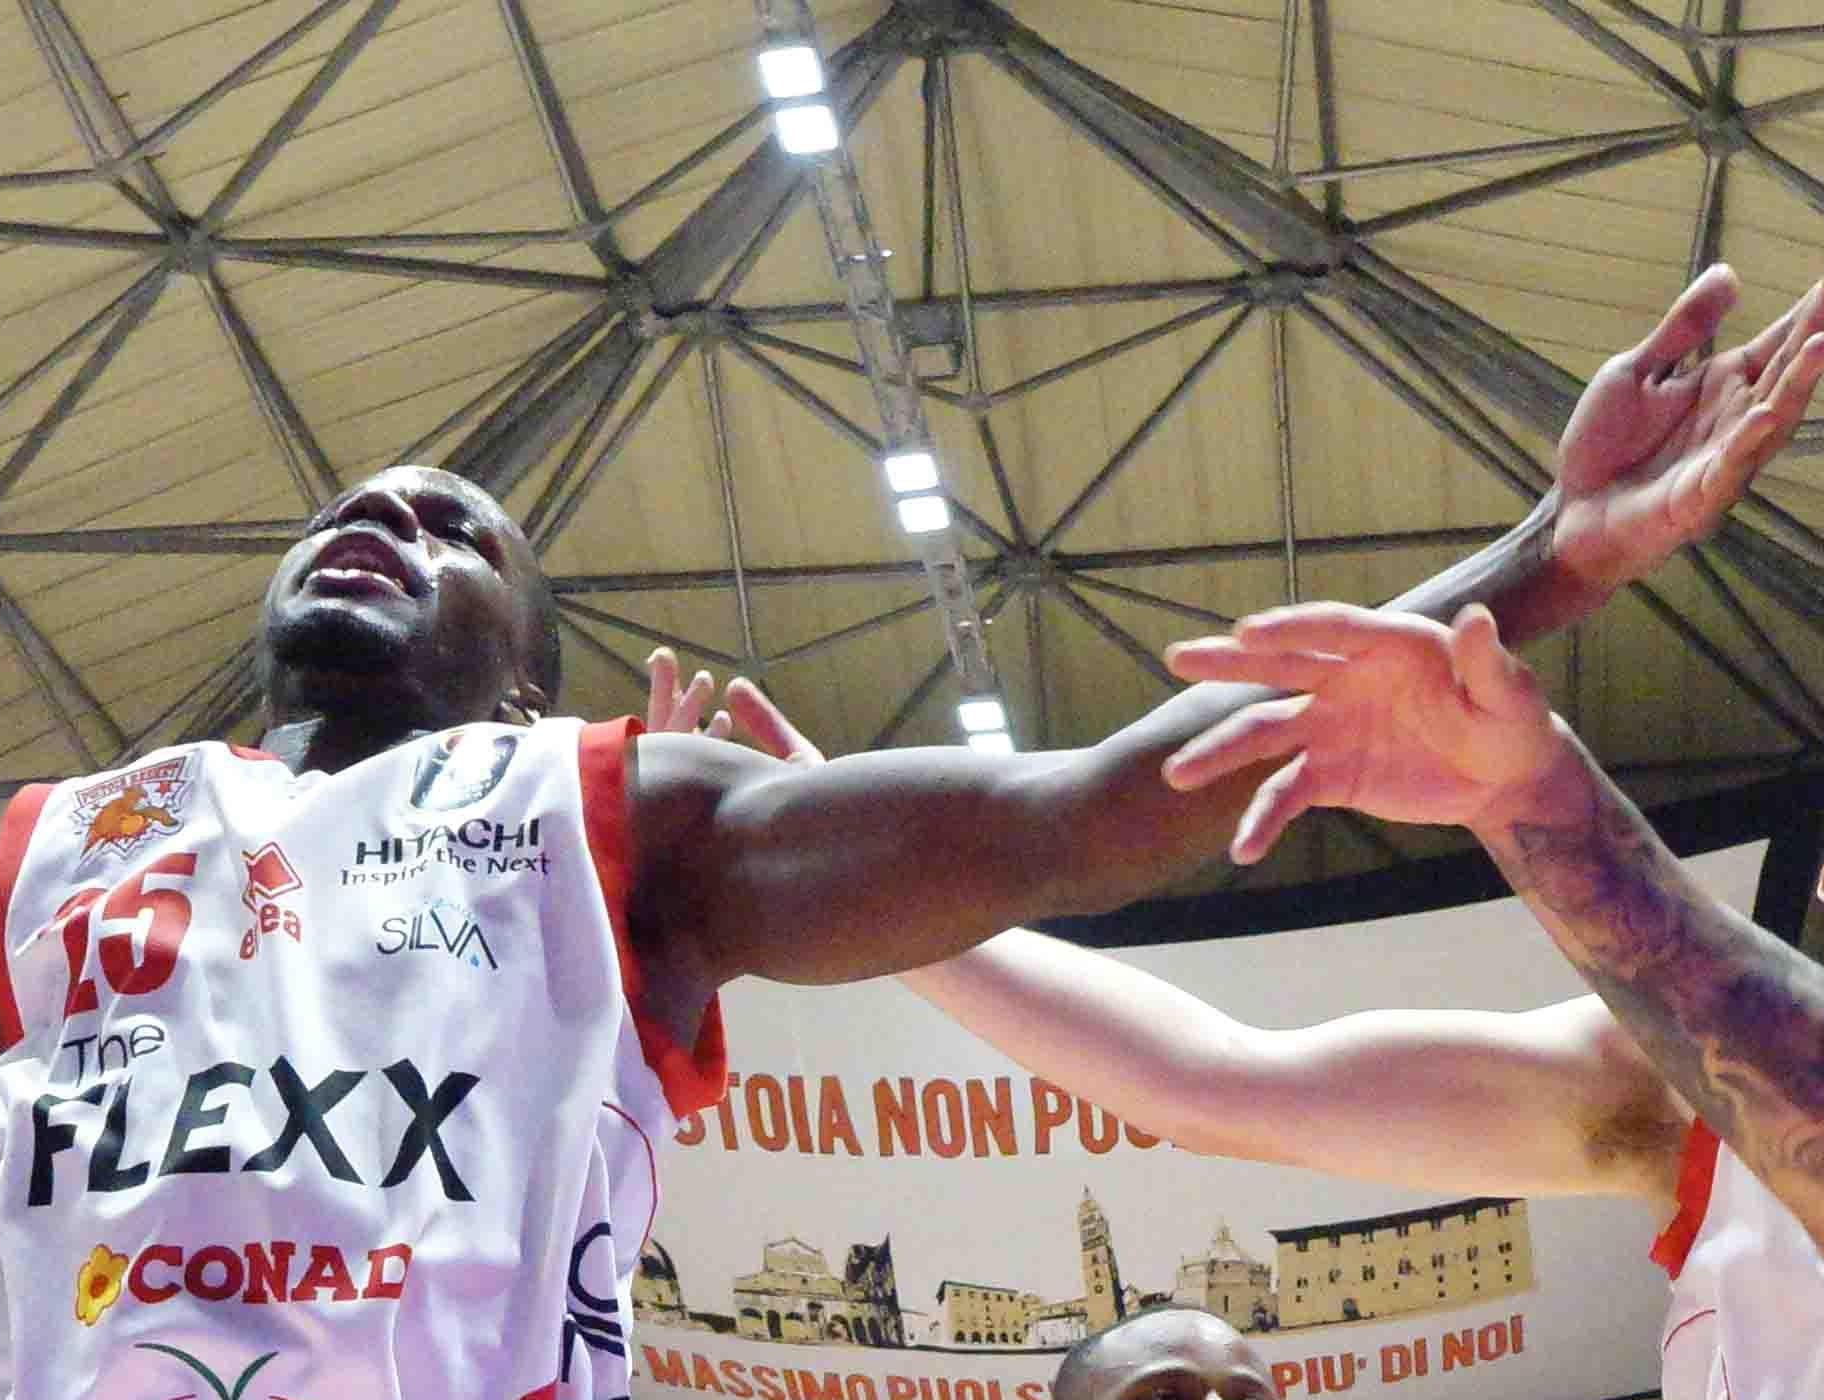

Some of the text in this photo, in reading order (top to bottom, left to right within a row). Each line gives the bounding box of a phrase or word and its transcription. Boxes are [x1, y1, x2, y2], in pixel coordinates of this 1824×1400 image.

[357, 819, 540, 866] HITACHI
[436, 846, 476, 874] the
[487, 853, 550, 876] Next
[377, 911, 497, 969] SILVA
[63, 1024, 164, 1087] The
[28, 1055, 480, 1206] FLEXX
[872, 1076, 1019, 1159] NON
[1029, 1077, 1166, 1155] PU
[128, 1242, 412, 1303] CONAD
[1379, 1338, 1428, 1383] DI
[1442, 1313, 1525, 1372] NOI
